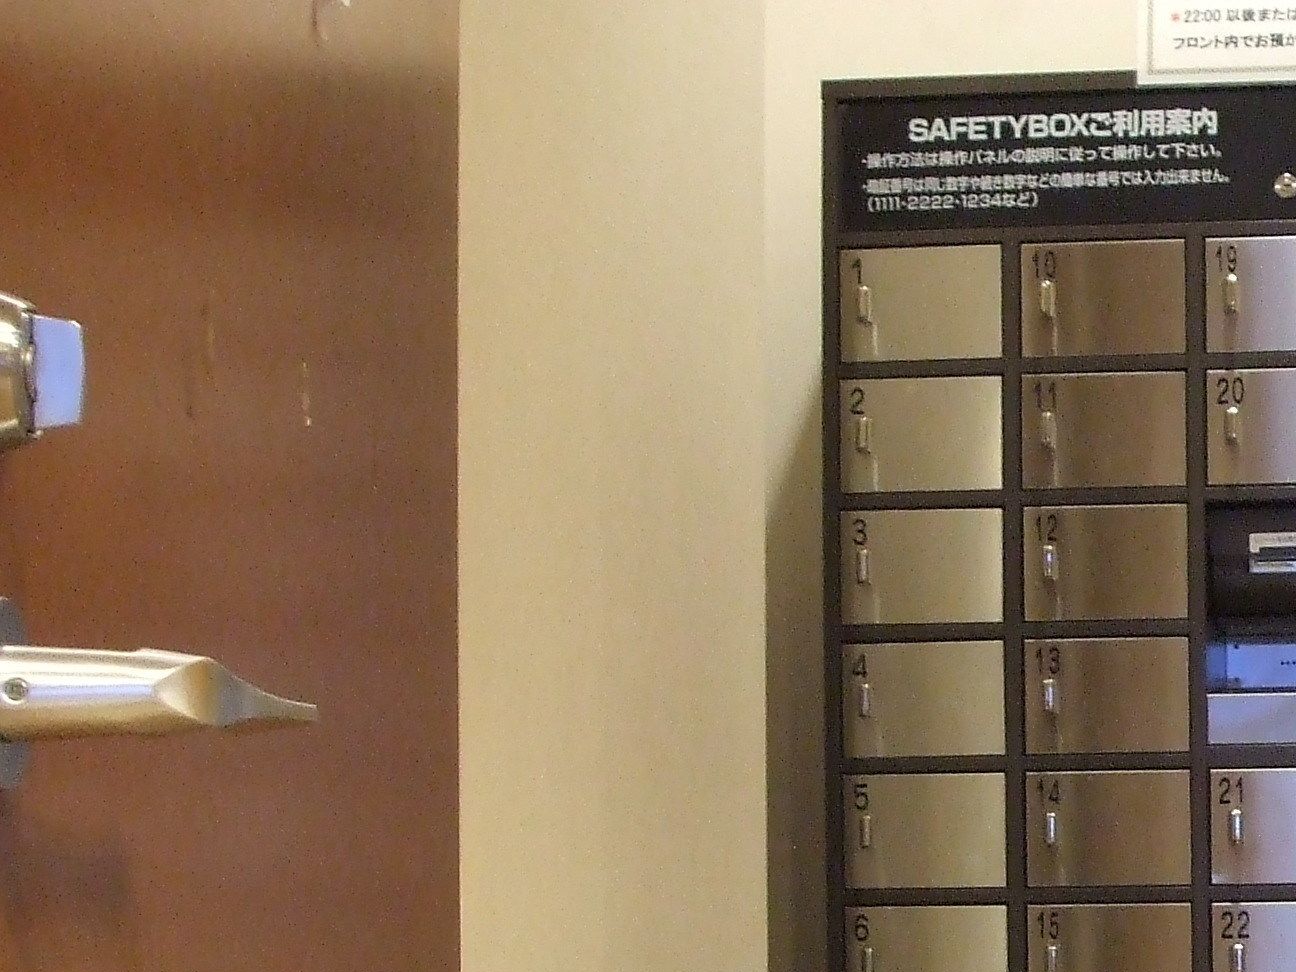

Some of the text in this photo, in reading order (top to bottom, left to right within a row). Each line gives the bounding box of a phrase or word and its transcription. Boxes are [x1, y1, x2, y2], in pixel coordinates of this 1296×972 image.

[908, 107, 1219, 142] SAFETYBOXご利用案内
[1215, 245, 1237, 272] 19
[850, 387, 866, 414] 2
[1216, 377, 1244, 404] 20
[852, 518, 868, 545] 3
[1034, 515, 1058, 542] 12
[852, 652, 868, 679] 4
[1036, 647, 1061, 674] 13
[853, 783, 868, 811] 5
[1037, 778, 1060, 806] 14
[1219, 776, 1243, 804] 21
[854, 914, 870, 942] 6
[1037, 911, 1060, 939] 15
[1221, 910, 1250, 938] 22
